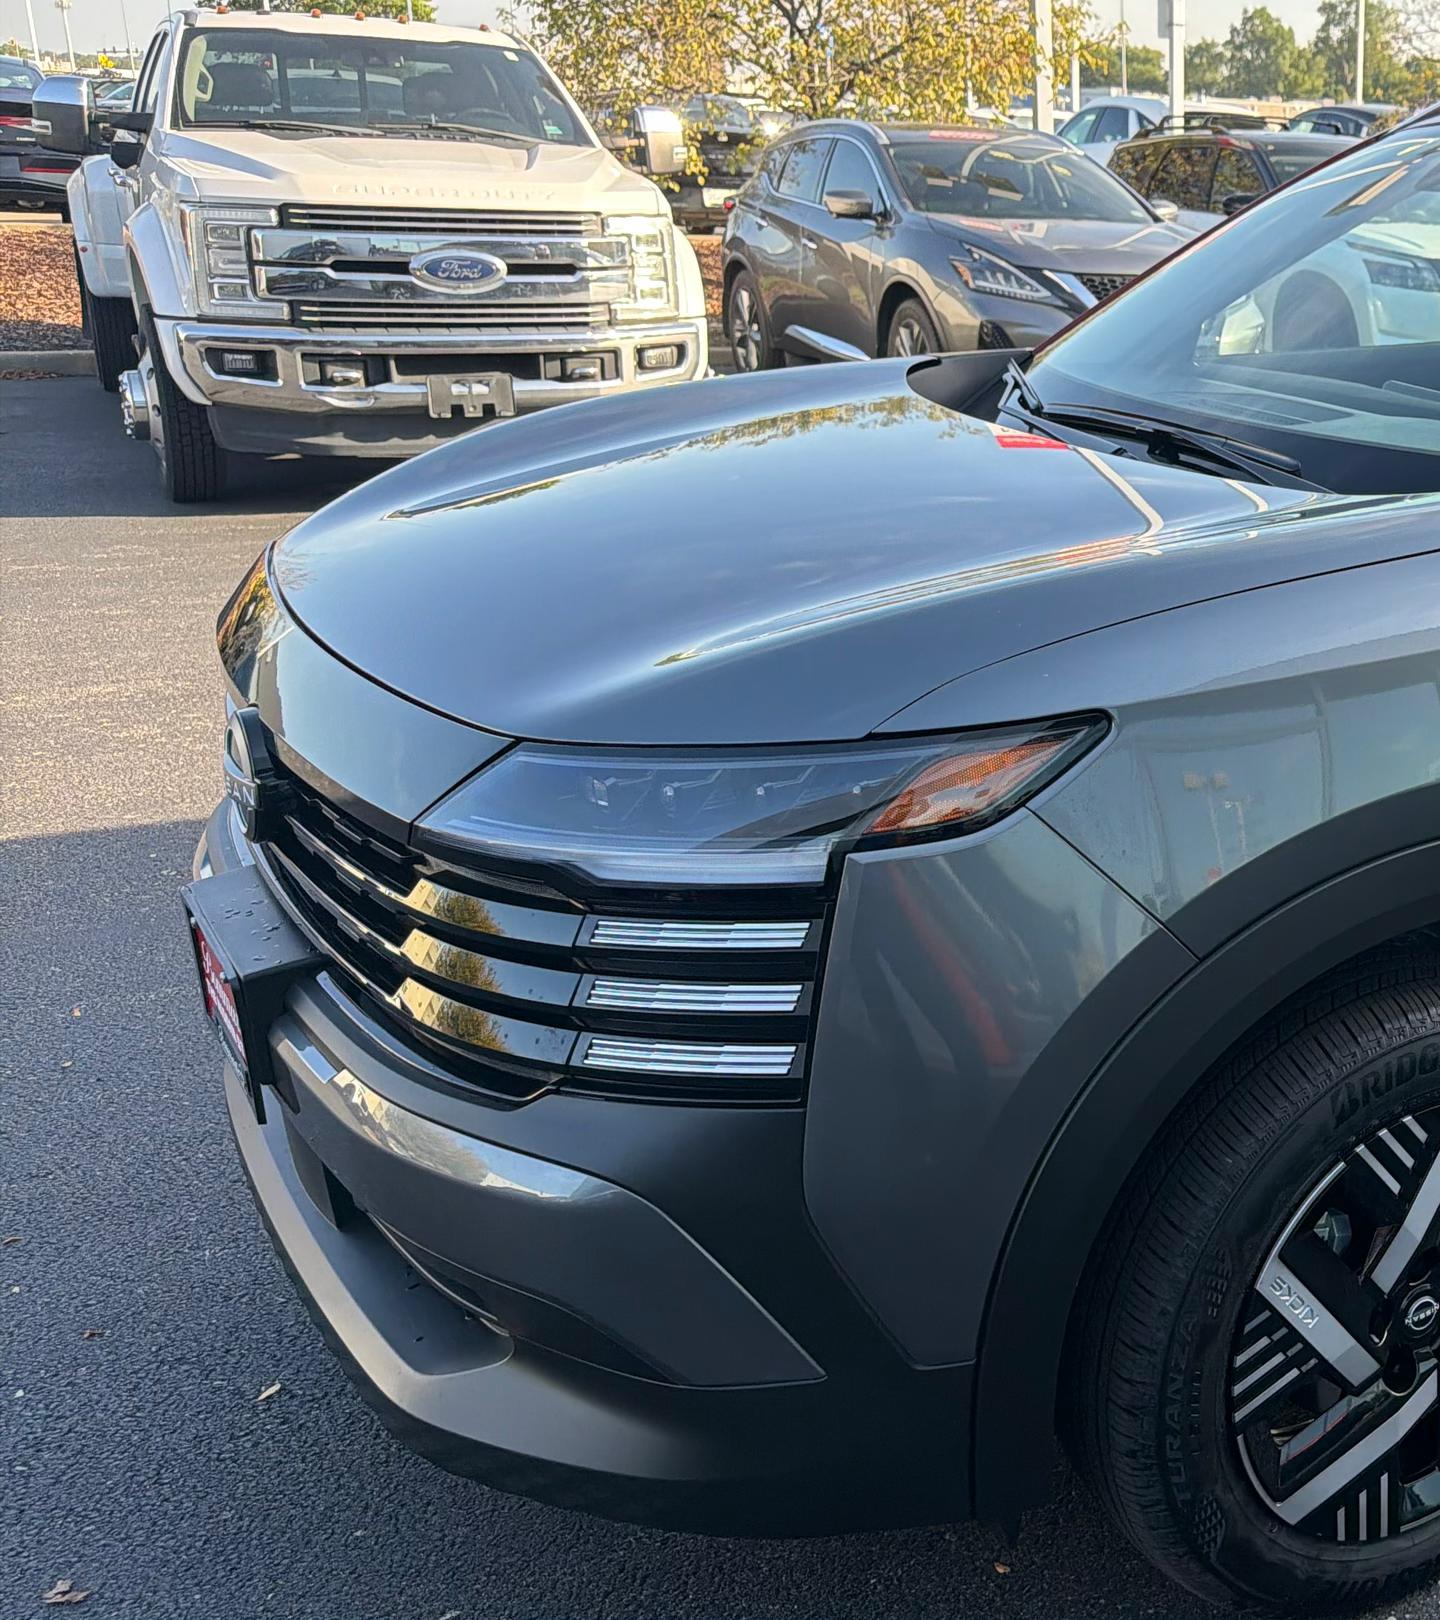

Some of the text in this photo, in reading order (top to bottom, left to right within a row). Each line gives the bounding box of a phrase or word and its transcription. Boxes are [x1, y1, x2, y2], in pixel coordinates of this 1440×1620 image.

[437, 259, 482, 281] Ford
[1270, 1276, 1320, 1329] KICKS
[1405, 1302, 1440, 1327] NISSAN
